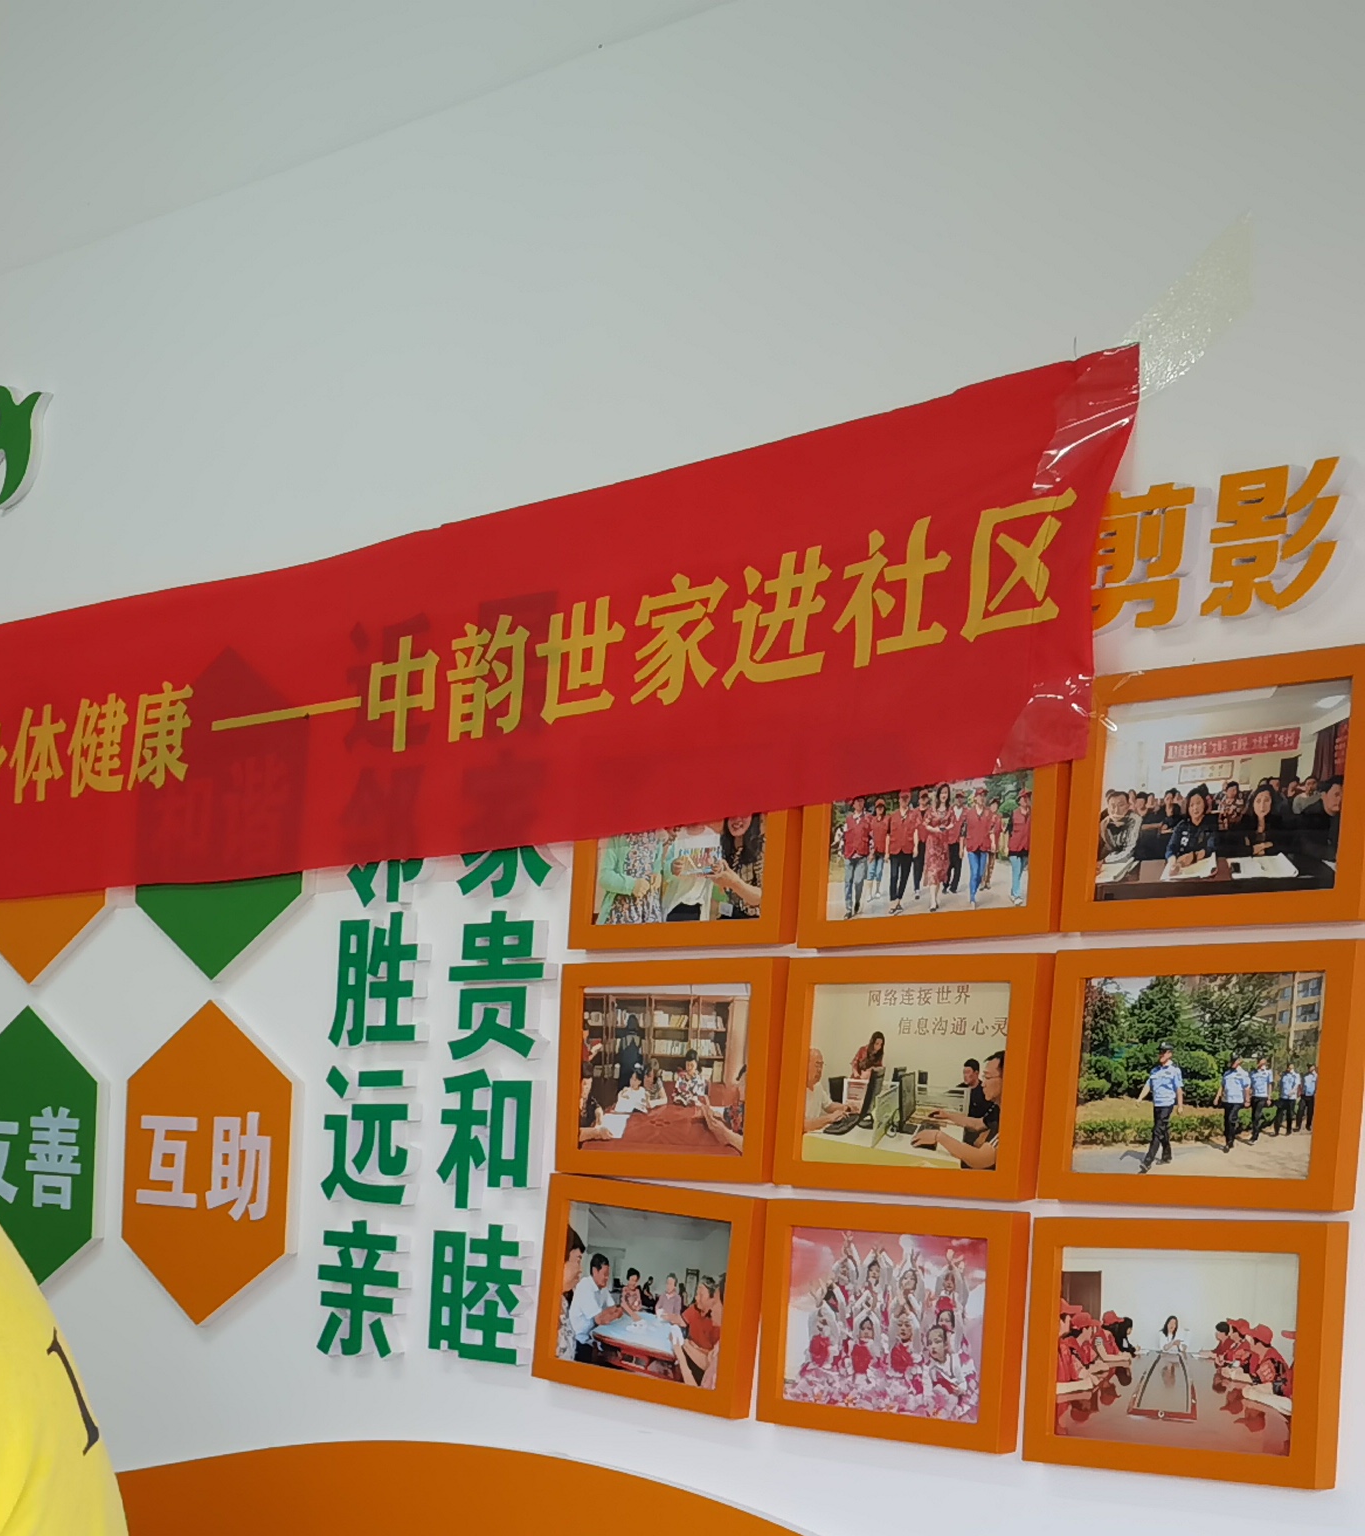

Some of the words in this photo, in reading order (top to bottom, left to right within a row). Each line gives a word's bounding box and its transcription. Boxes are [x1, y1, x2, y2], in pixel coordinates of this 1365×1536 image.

[1091, 456, 1340, 630] 剪影
[868, 985, 971, 1007] 网络连接世界
[898, 1016, 1008, 1037] 信息沟通心灵
[135, 1111, 272, 1222] 互助
